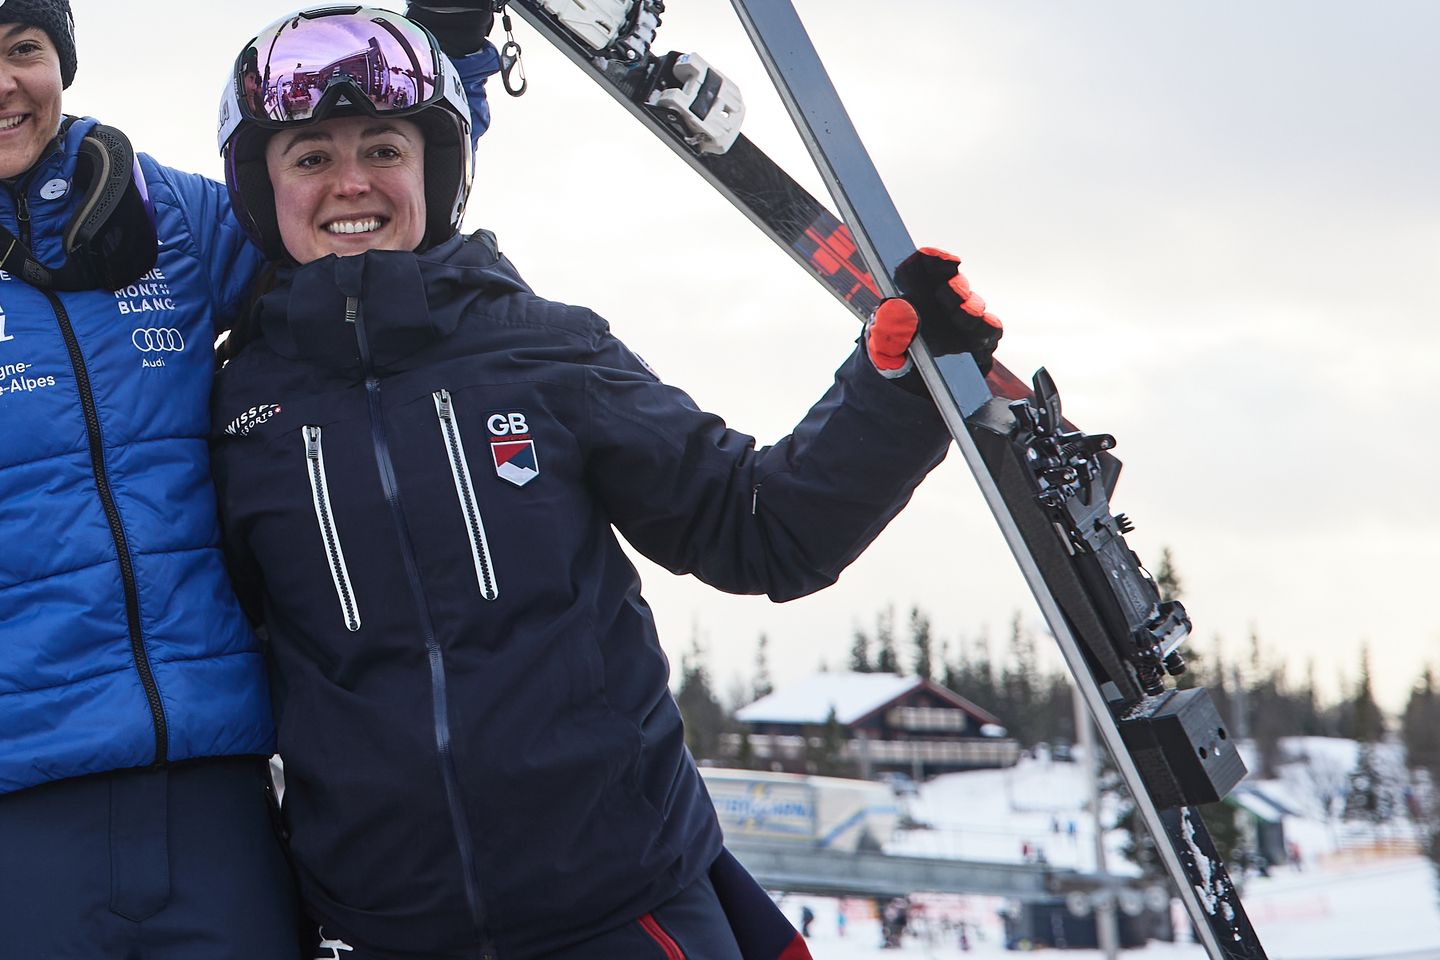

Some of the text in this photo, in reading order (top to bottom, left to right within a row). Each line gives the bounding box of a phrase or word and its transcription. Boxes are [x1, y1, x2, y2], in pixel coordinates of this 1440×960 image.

[117, 297, 176, 315] BLANC
[142, 356, 166, 368] Audi
[240, 410, 274, 436] ESORTS
[487, 412, 530, 436] GB
